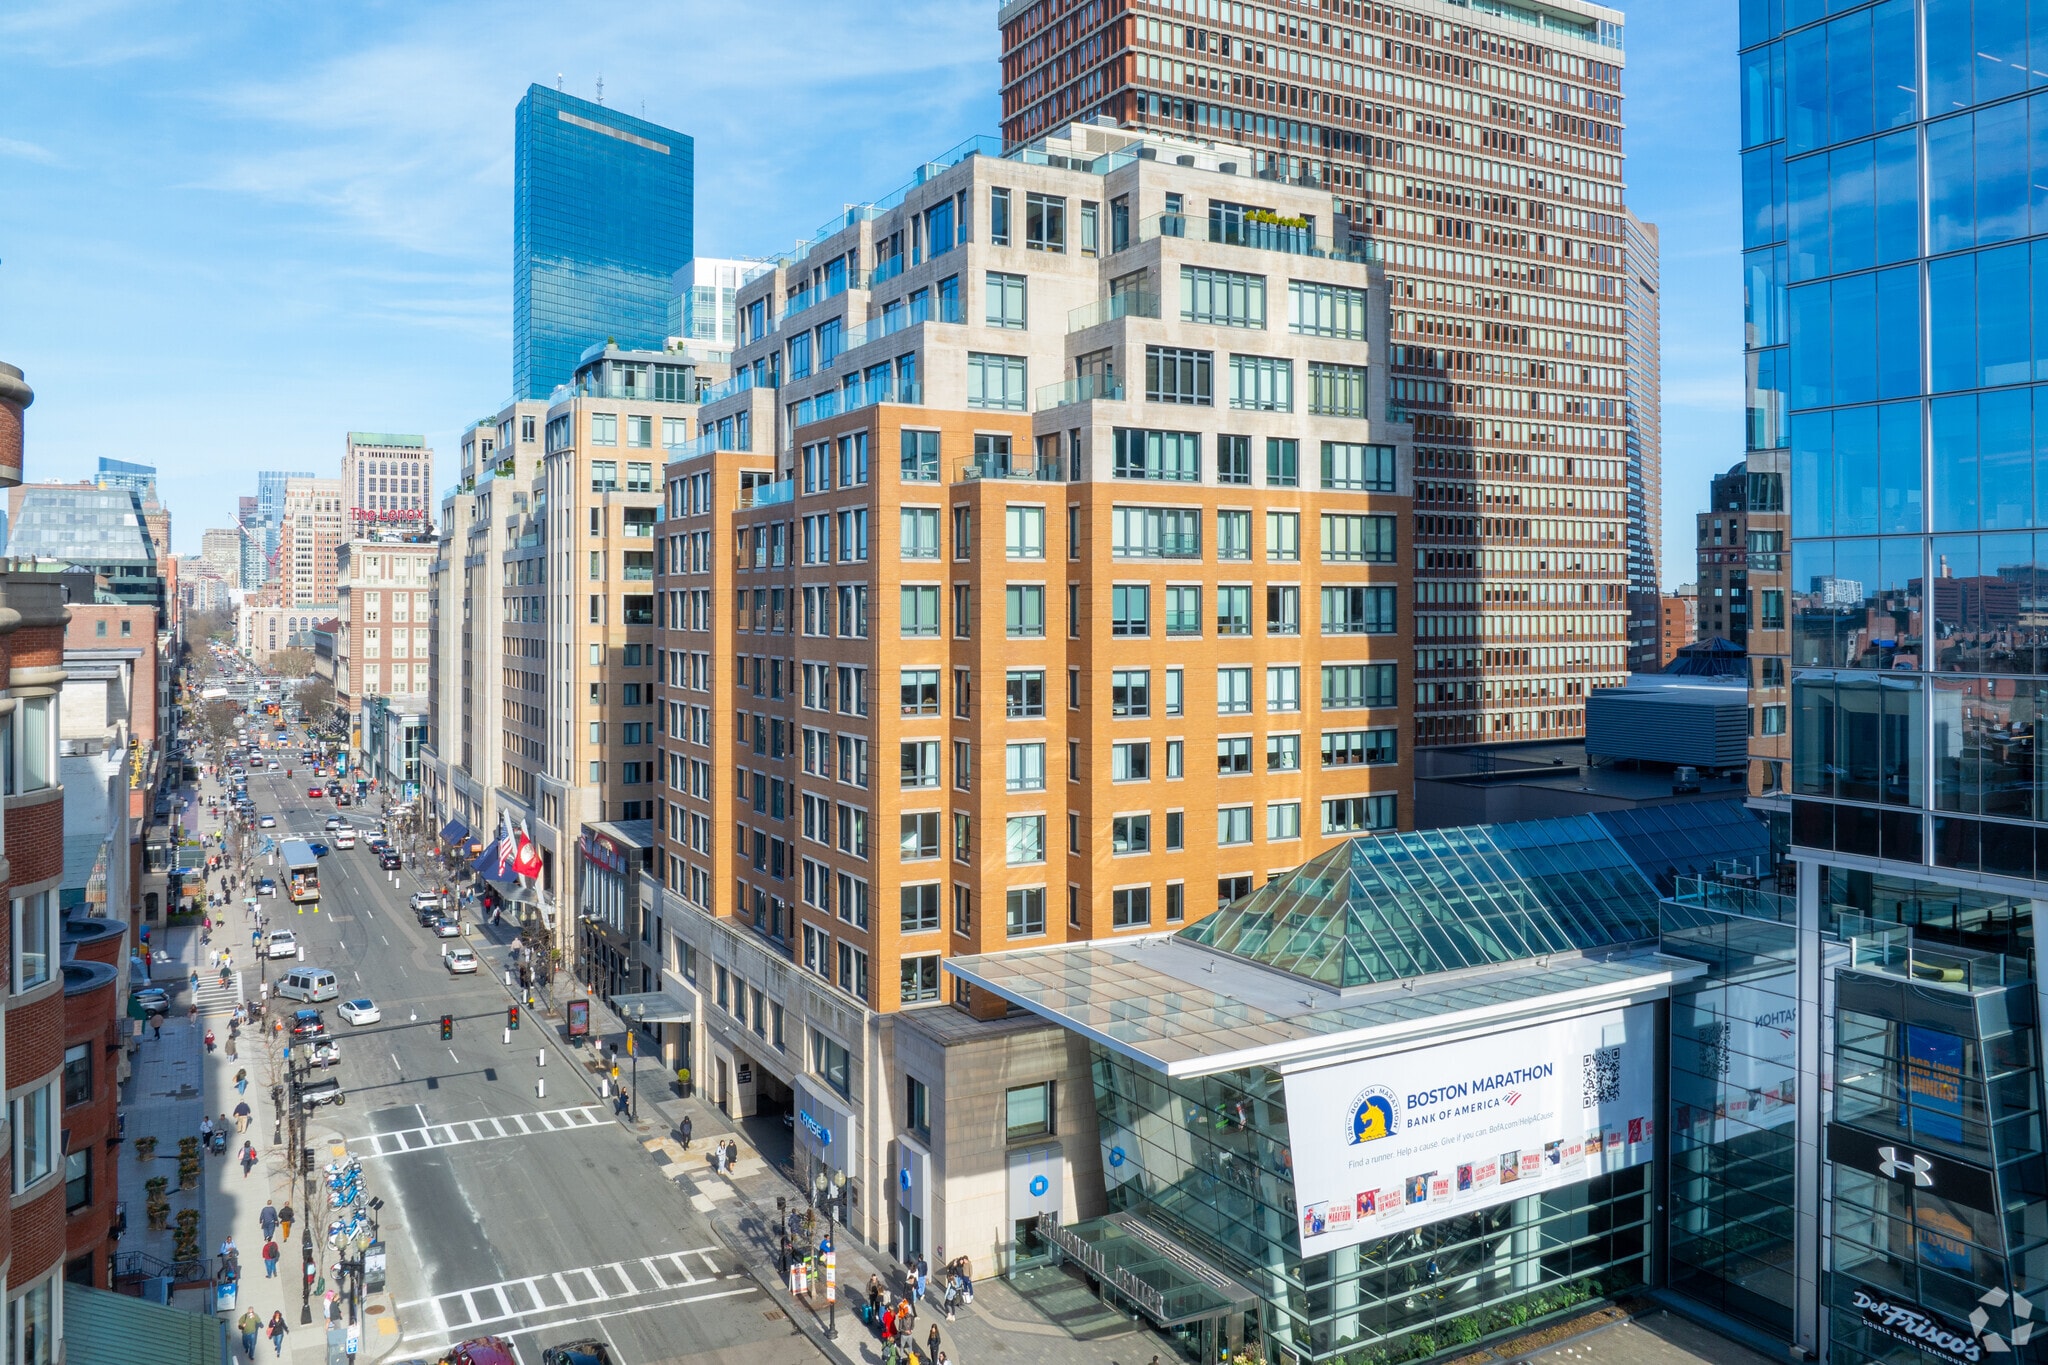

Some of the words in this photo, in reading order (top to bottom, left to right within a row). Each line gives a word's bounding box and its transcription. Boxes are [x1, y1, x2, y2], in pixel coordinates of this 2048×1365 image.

[350, 507, 376, 520] The
[380, 506, 424, 520] Lenox
[1407, 1082, 1468, 1110] BOSTON
[1472, 1062, 1553, 1095] MARATHON
[800, 1109, 822, 1140] CHASE
[1351, 1088, 1375, 1115] BOSTON
[1379, 1088, 1399, 1128] MARATHON
[1407, 1113, 1436, 1128] BANK
[1439, 1109, 1452, 1121] OF
[1454, 1097, 1500, 1117] AMERICA
[1348, 1157, 1364, 1169] Find
[1365, 1157, 1370, 1165] a
[1371, 1153, 1394, 1165] runner.
[1397, 1146, 1412, 1158] Help
[1419, 1141, 1439, 1152] cause.
[1441, 1136, 1455, 1146] Give
[1456, 1133, 1461, 1142] if
[1462, 1132, 1474, 1142] you
[1328, 1210, 1351, 1224] MARATHON
[1038, 1211, 1107, 1277] PRUDENTIAL
[1116, 1265, 1169, 1320] CENTER
[1852, 1291, 1888, 1317] Del
[1882, 1305, 1981, 1362] Frisco's
[1863, 1319, 1891, 1335] DOUBLE
[1893, 1332, 1917, 1347] EAGLE
